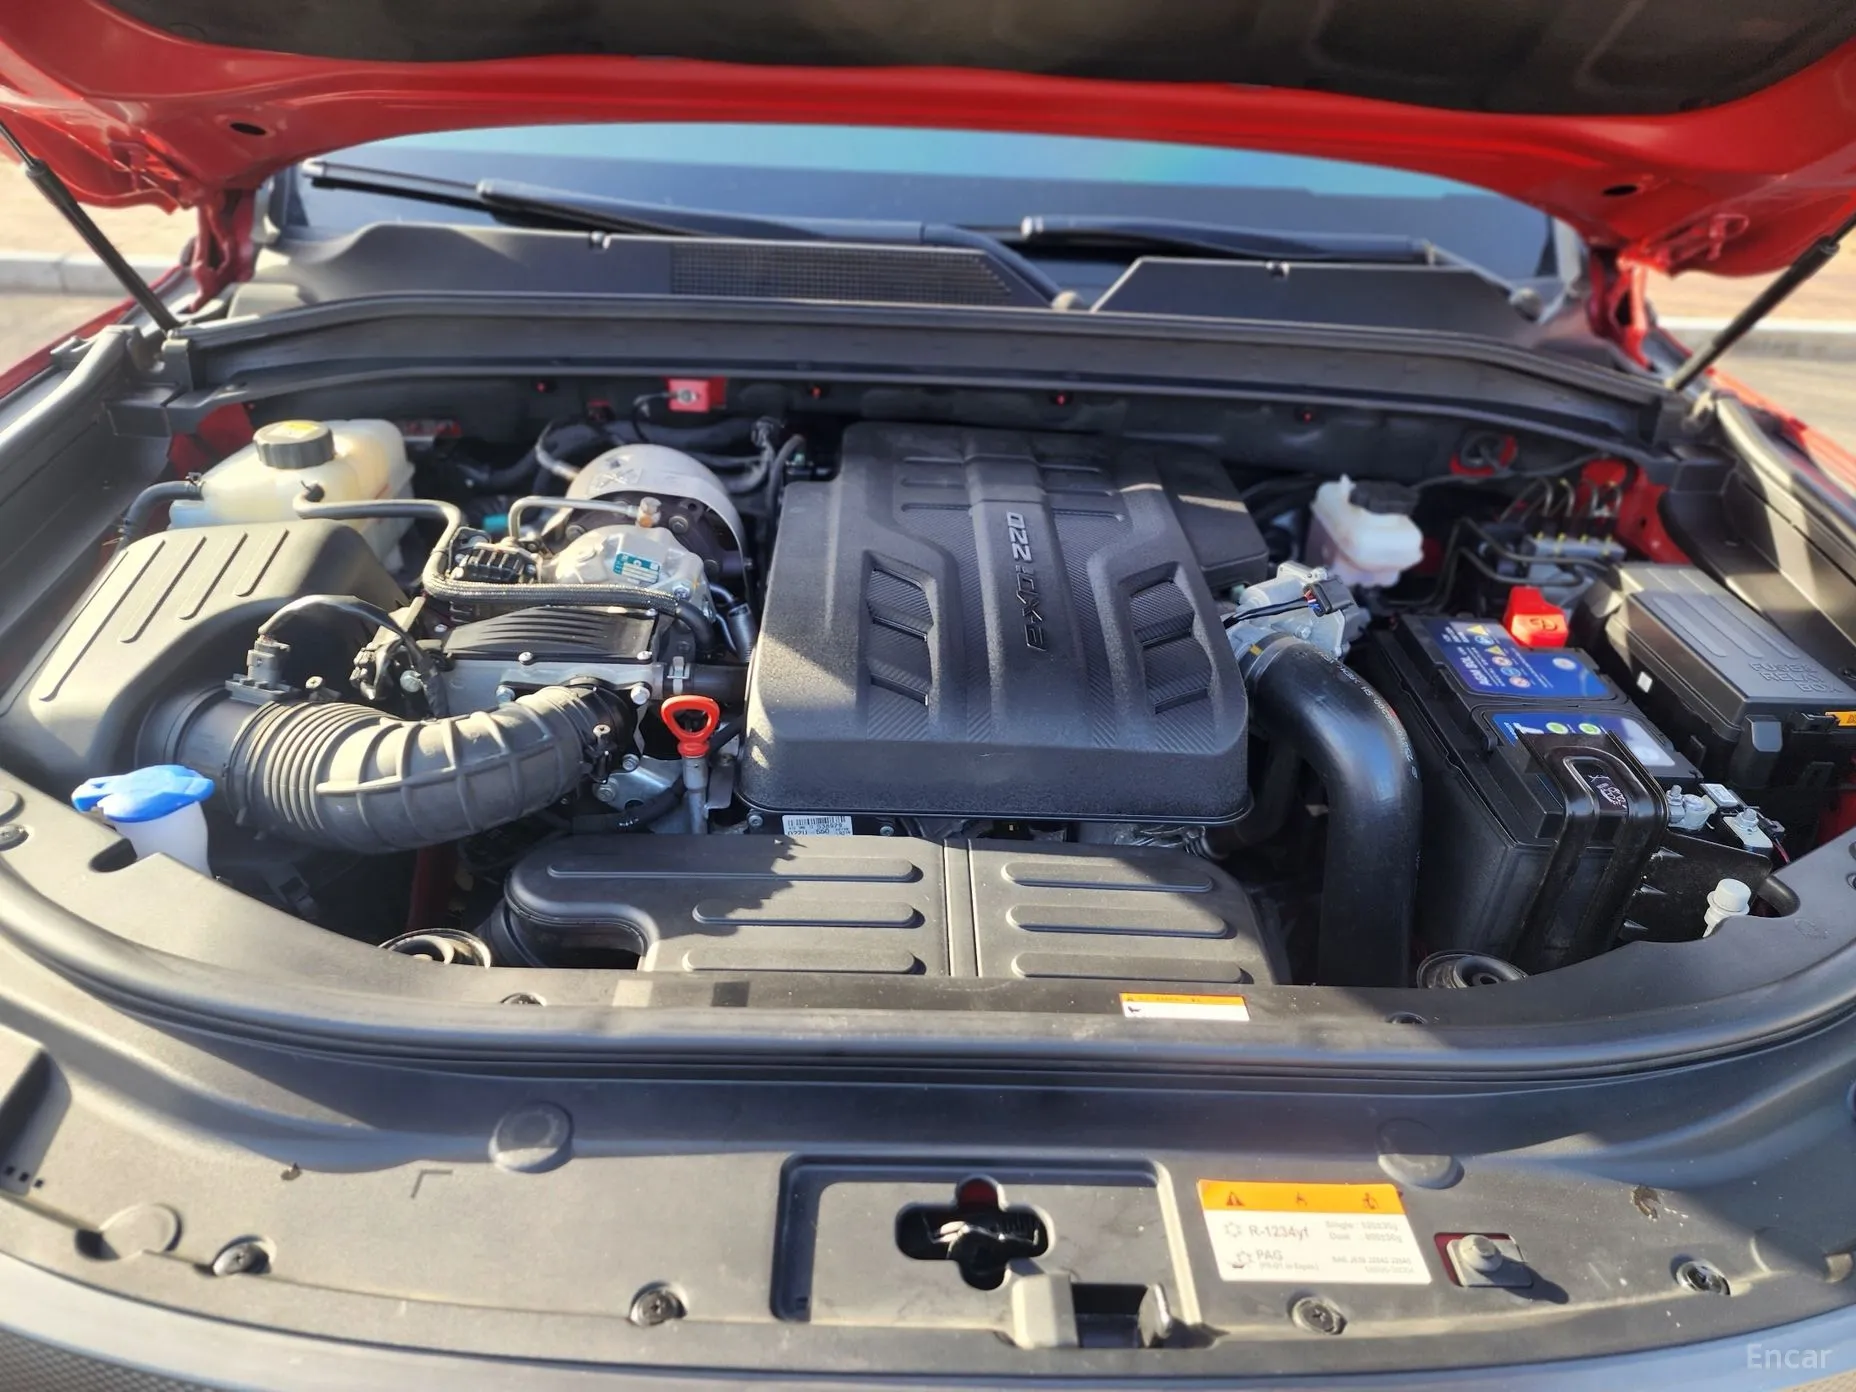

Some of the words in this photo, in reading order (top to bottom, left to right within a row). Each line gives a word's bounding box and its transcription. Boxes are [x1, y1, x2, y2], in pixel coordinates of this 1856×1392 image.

[1795, 682, 1845, 693] BOX
[1248, 1225, 1310, 1240] R-1234yf
[1256, 1249, 1284, 1261] PAG
